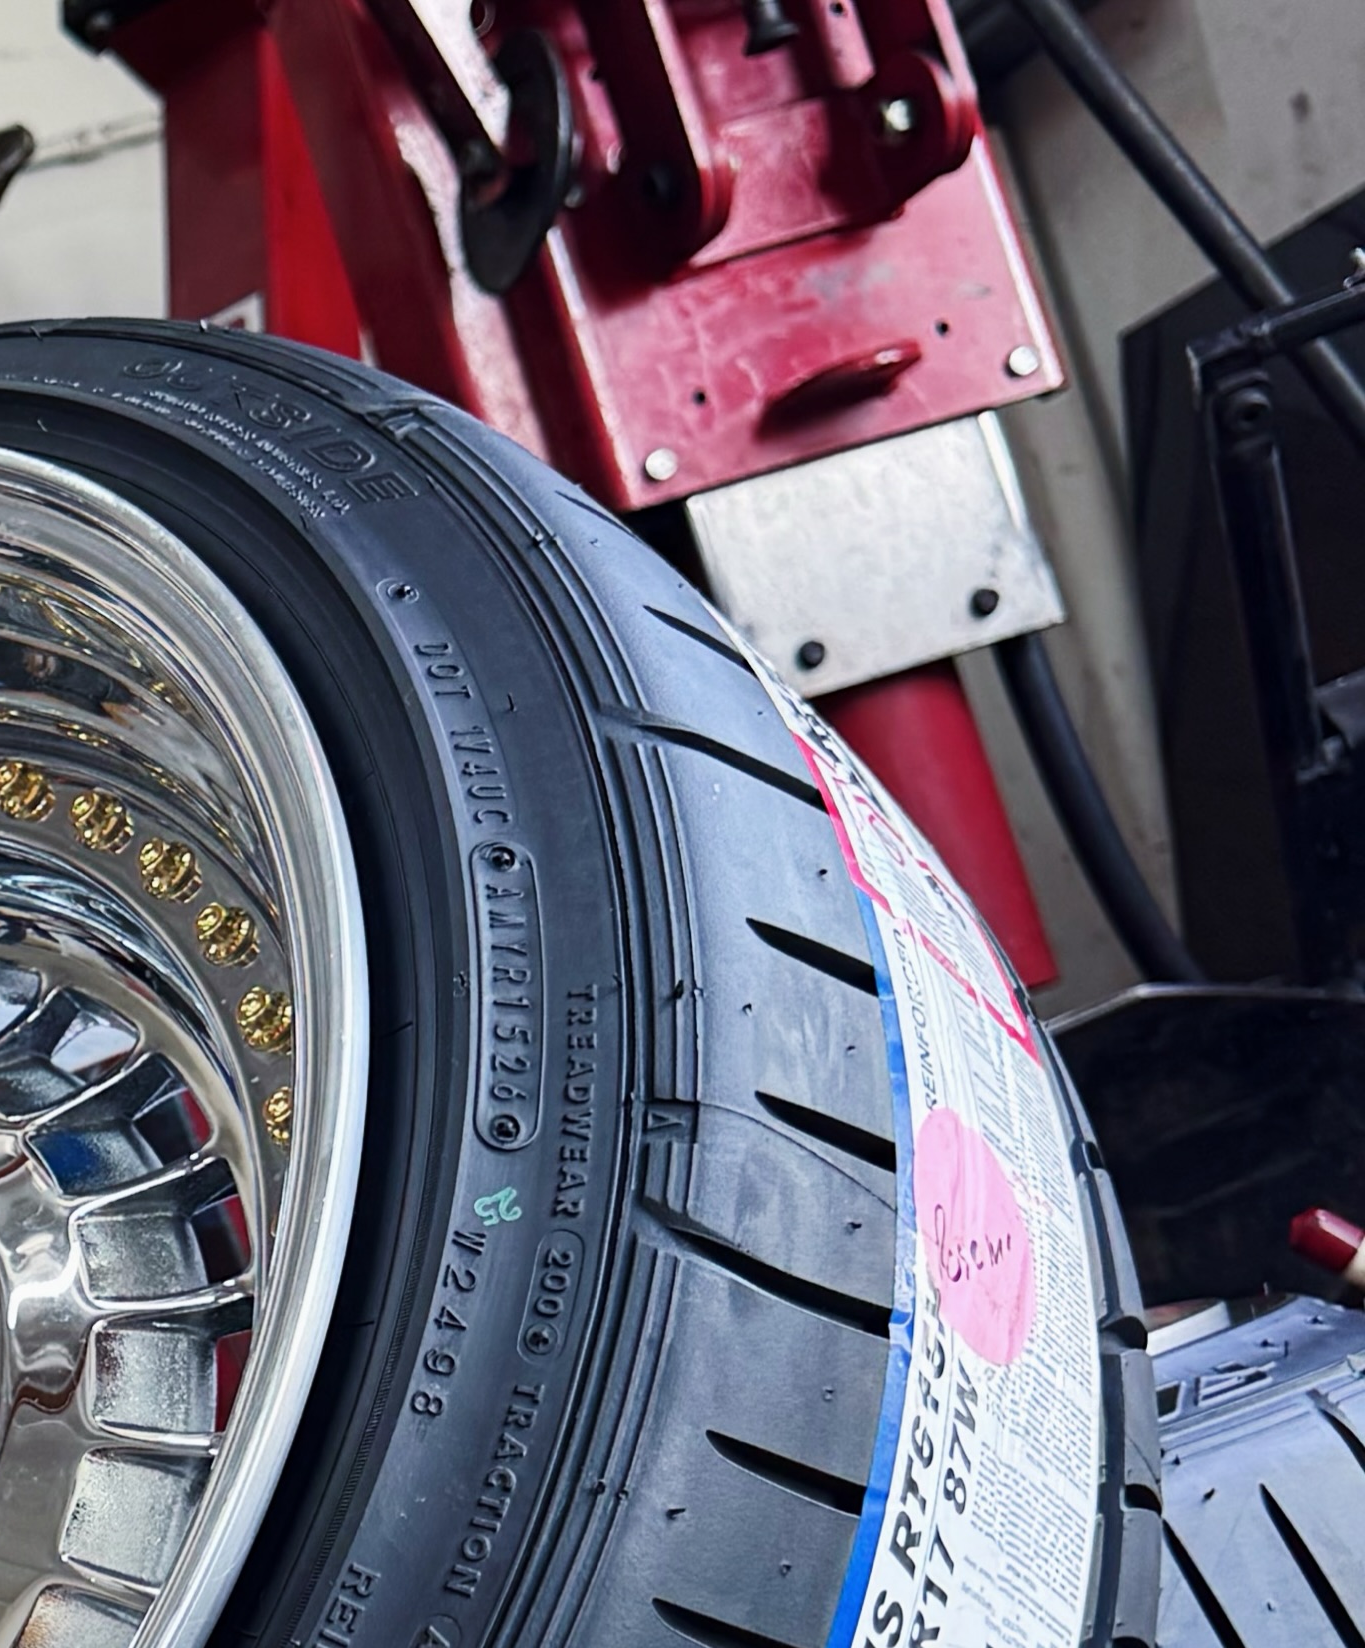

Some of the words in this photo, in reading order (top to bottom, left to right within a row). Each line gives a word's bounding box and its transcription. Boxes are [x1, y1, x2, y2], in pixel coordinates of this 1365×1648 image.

[414, 640, 471, 701] DOT
[553, 984, 599, 1219] TREADWEAR
[407, 1230, 488, 1419] W2498
[528, 1250, 574, 1319] 200
[446, 1382, 545, 1600] TRACTION
[942, 1362, 988, 1513] 87W
